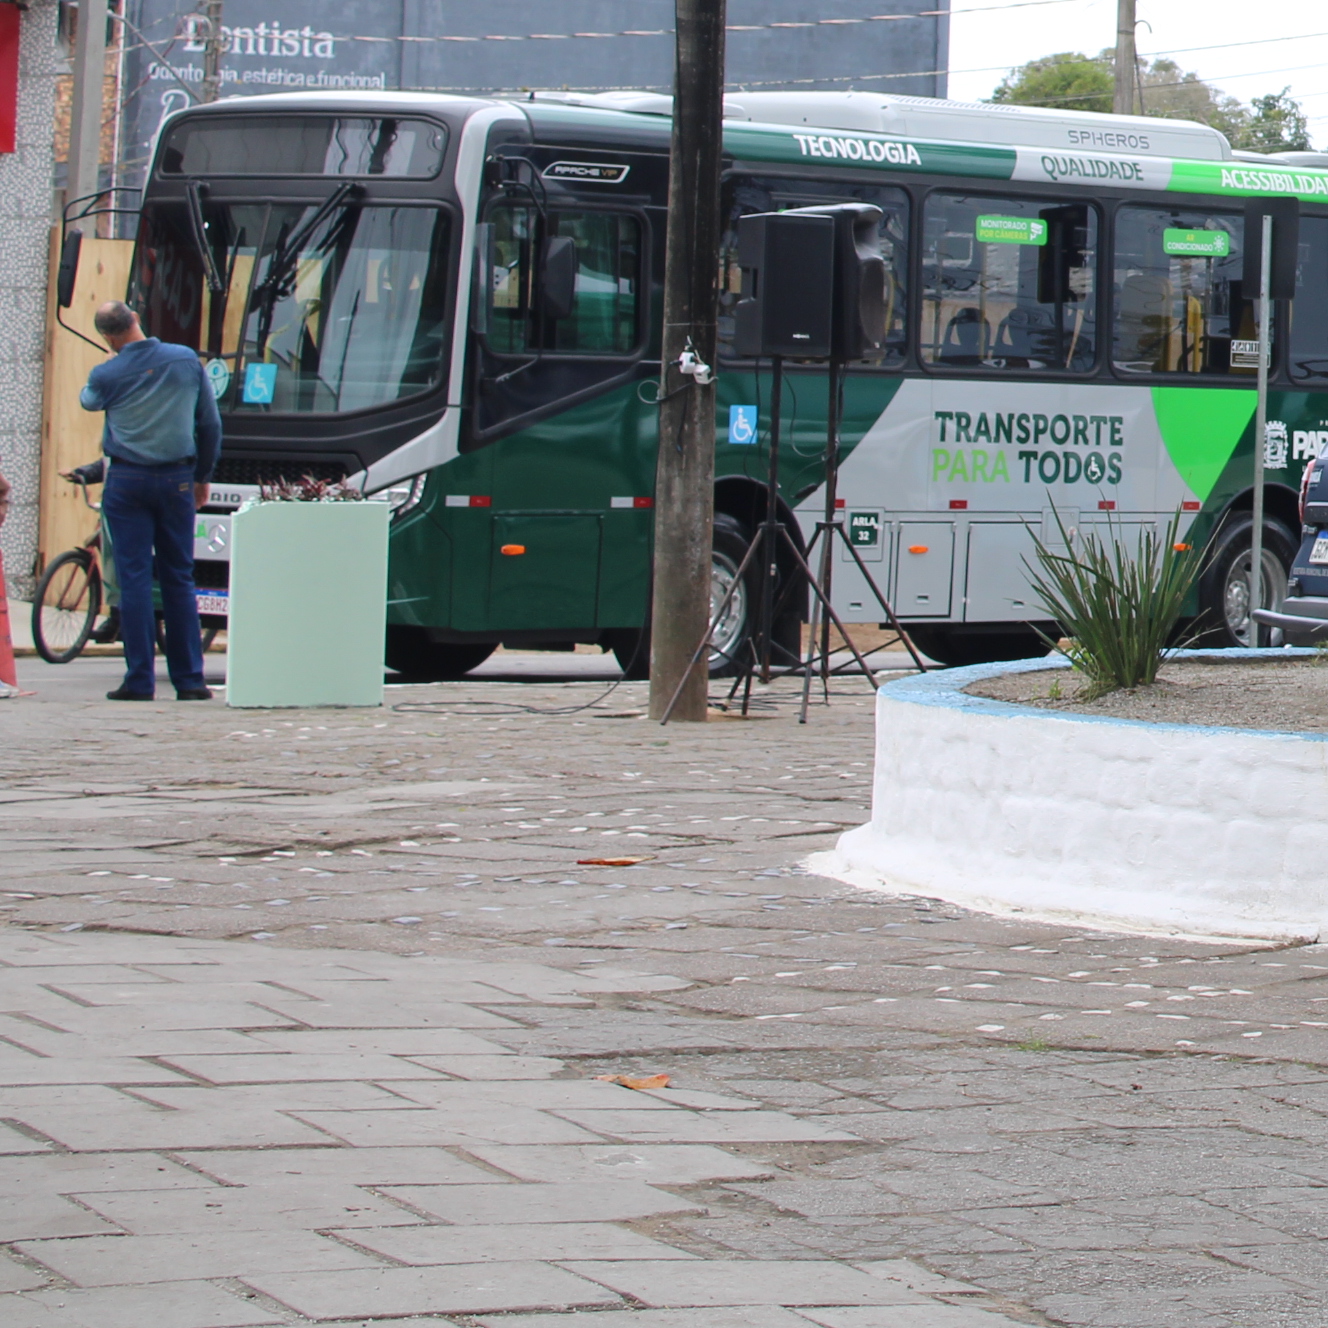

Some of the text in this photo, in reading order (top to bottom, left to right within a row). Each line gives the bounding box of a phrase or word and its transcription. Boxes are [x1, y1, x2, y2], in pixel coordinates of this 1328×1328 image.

[243, 64, 304, 86] estética
[1067, 129, 1151, 150] SPHEROS
[793, 133, 922, 166] TECNOLOGIA
[601, 168, 618, 177] VIP
[1041, 155, 1145, 181] QUALIDADE
[980, 219, 1028, 231] MONITORADO
[1166, 242, 1214, 253] CONDICIONADO
[934, 410, 1124, 447] TRANSPORTE
[932, 447, 1123, 485] PARA TODOS
[210, 492, 242, 504] AIO
[852, 516, 877, 527] ARLA
[857, 530, 870, 542] 32
[197, 596, 228, 612] CG8H2
